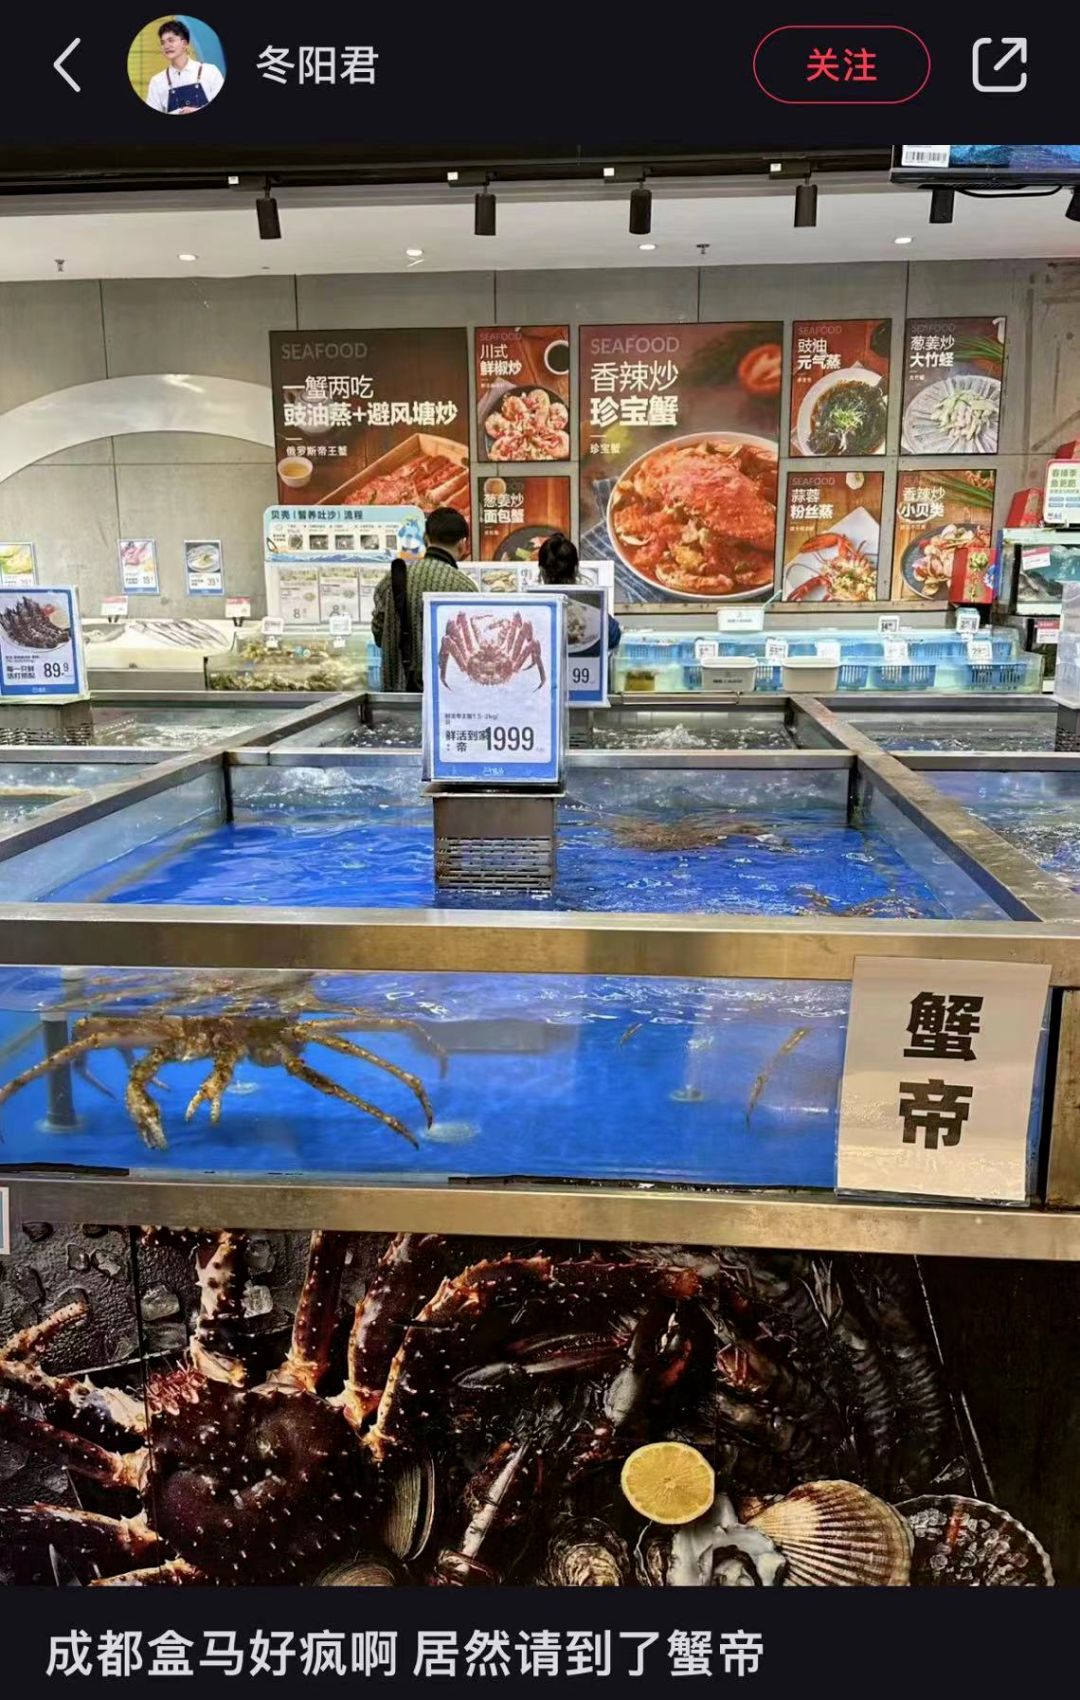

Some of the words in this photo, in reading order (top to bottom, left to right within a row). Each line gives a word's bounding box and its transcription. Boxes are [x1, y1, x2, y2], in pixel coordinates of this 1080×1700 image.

[479, 332, 522, 341] SEAFOOD
[797, 325, 842, 335] SEAFOOD
[280, 342, 368, 360] SEAFOOD
[480, 343, 508, 359] 川式
[590, 336, 680, 354] SEAFOOD
[797, 337, 827, 353] 豉油
[910, 334, 955, 351] 葱姜炒
[479, 359, 523, 376] 鲜椒炒
[797, 353, 842, 370] 元气蒸
[590, 359, 679, 393] 香辣炒
[282, 374, 375, 400] 一蟹两吃
[282, 400, 458, 427] 豉油蒸+避风塘炒
[589, 395, 679, 428] 珍宝蟹
[286, 445, 349, 457] 俄罗斯帝王蟹
[589, 442, 621, 455] 珍宝蟹
[791, 476, 836, 486] SEAFOOD
[483, 492, 525, 508] 葱姜炒
[791, 488, 820, 503] 蒜蓉
[903, 486, 946, 502] 香辣炒
[483, 508, 525, 524] 面包蟹
[790, 503, 834, 520] 粉丝蒸
[901, 502, 945, 518] 小贝类
[572, 667, 590, 684] 99
[485, 726, 535, 751] 1999
[899, 991, 984, 1150] 蟹帝
